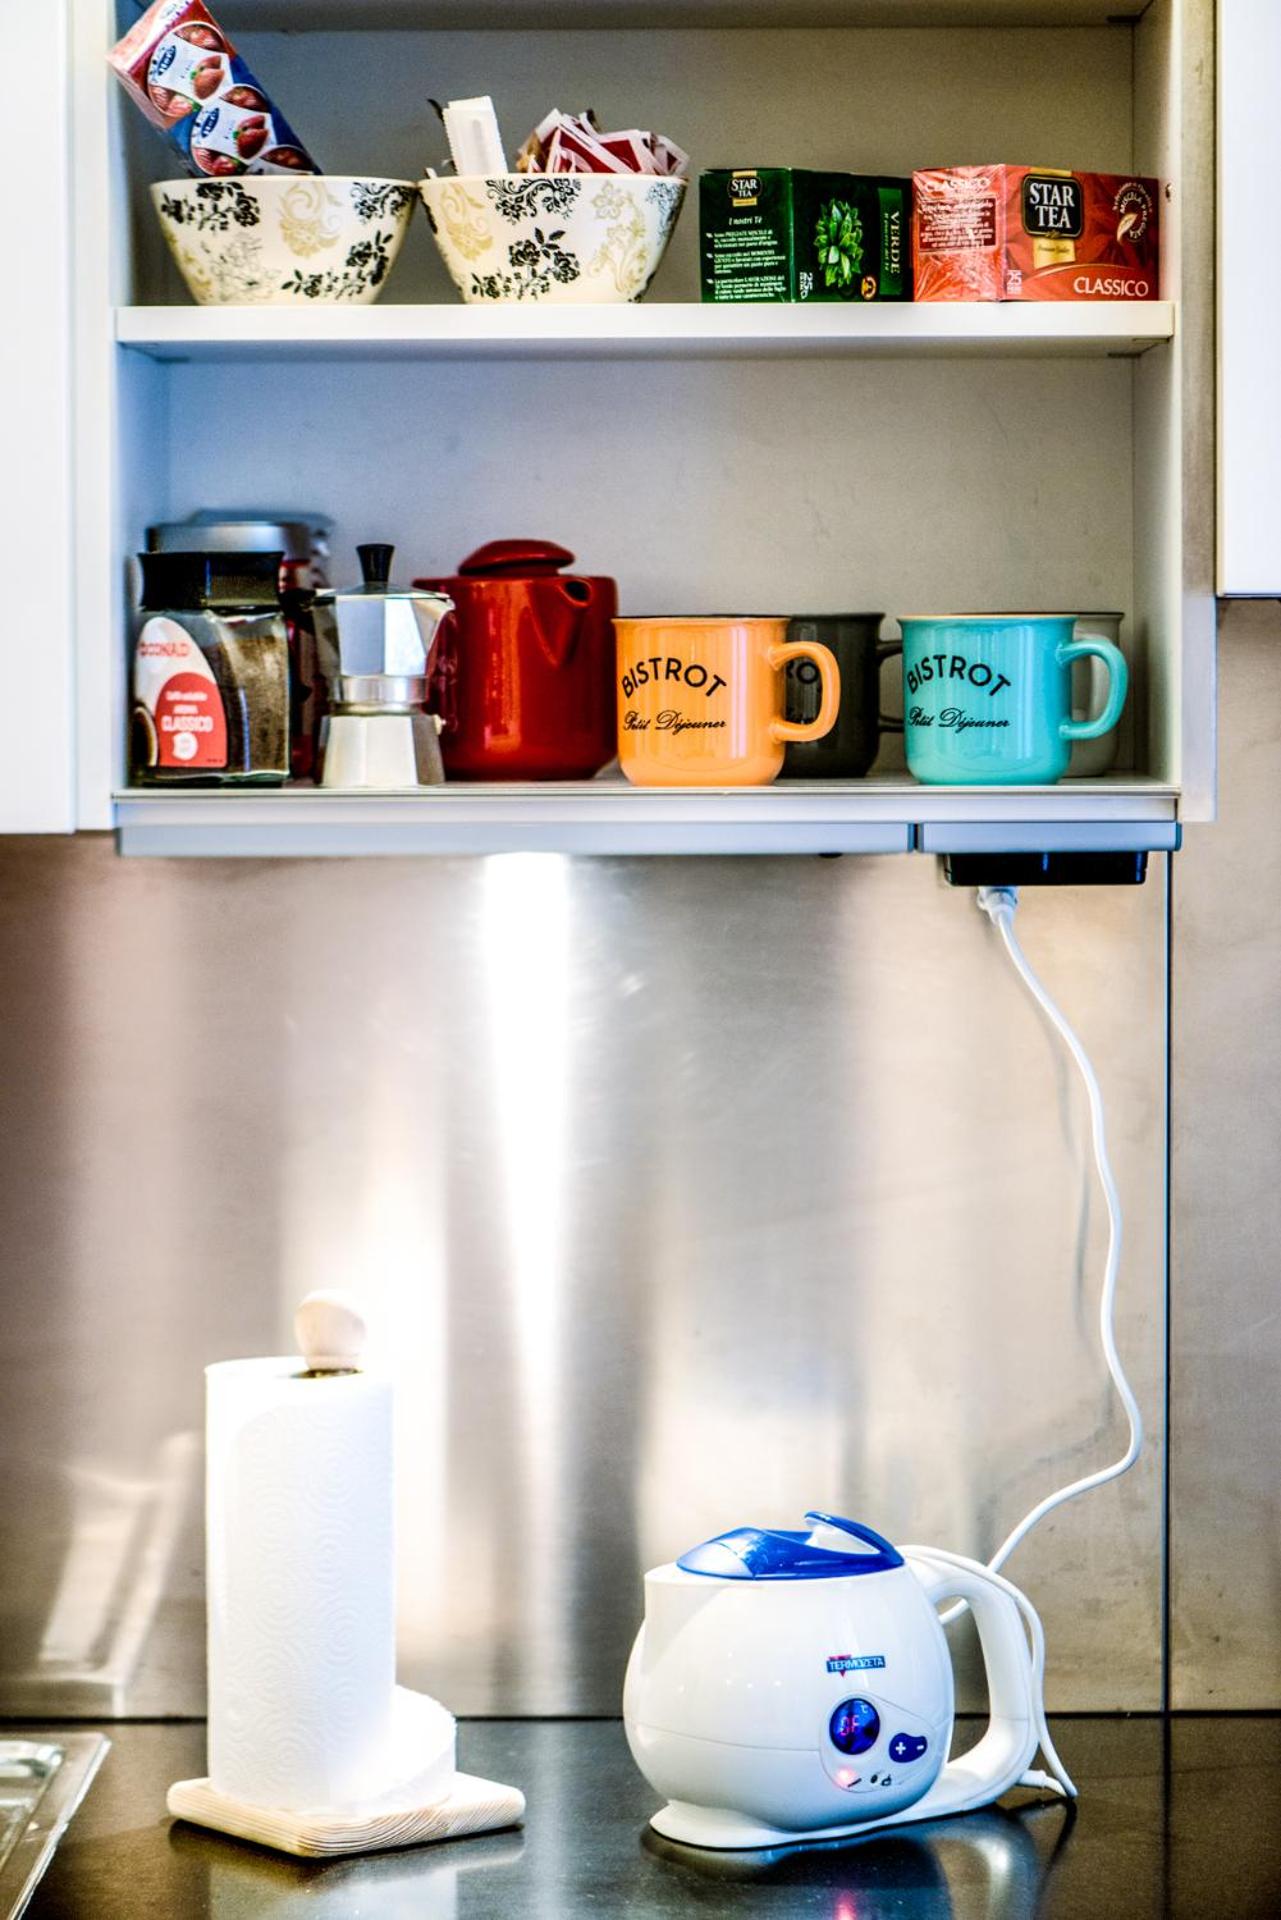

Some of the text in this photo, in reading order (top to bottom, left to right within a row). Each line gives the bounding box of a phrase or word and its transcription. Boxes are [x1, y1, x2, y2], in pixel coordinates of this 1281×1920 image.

[731, 179, 758, 190] STAR
[738, 190, 752, 198] TEA
[1029, 182, 1075, 207] STAR
[1035, 205, 1071, 229] TEA
[890, 211, 900, 274] VERDE
[1007, 271, 1023, 286] 25
[1074, 276, 1149, 297] CLASSICO
[621, 657, 727, 698] BISTROT
[907, 654, 1011, 697] BISTROT
[829, 1657, 885, 1671] TERMOZETA
